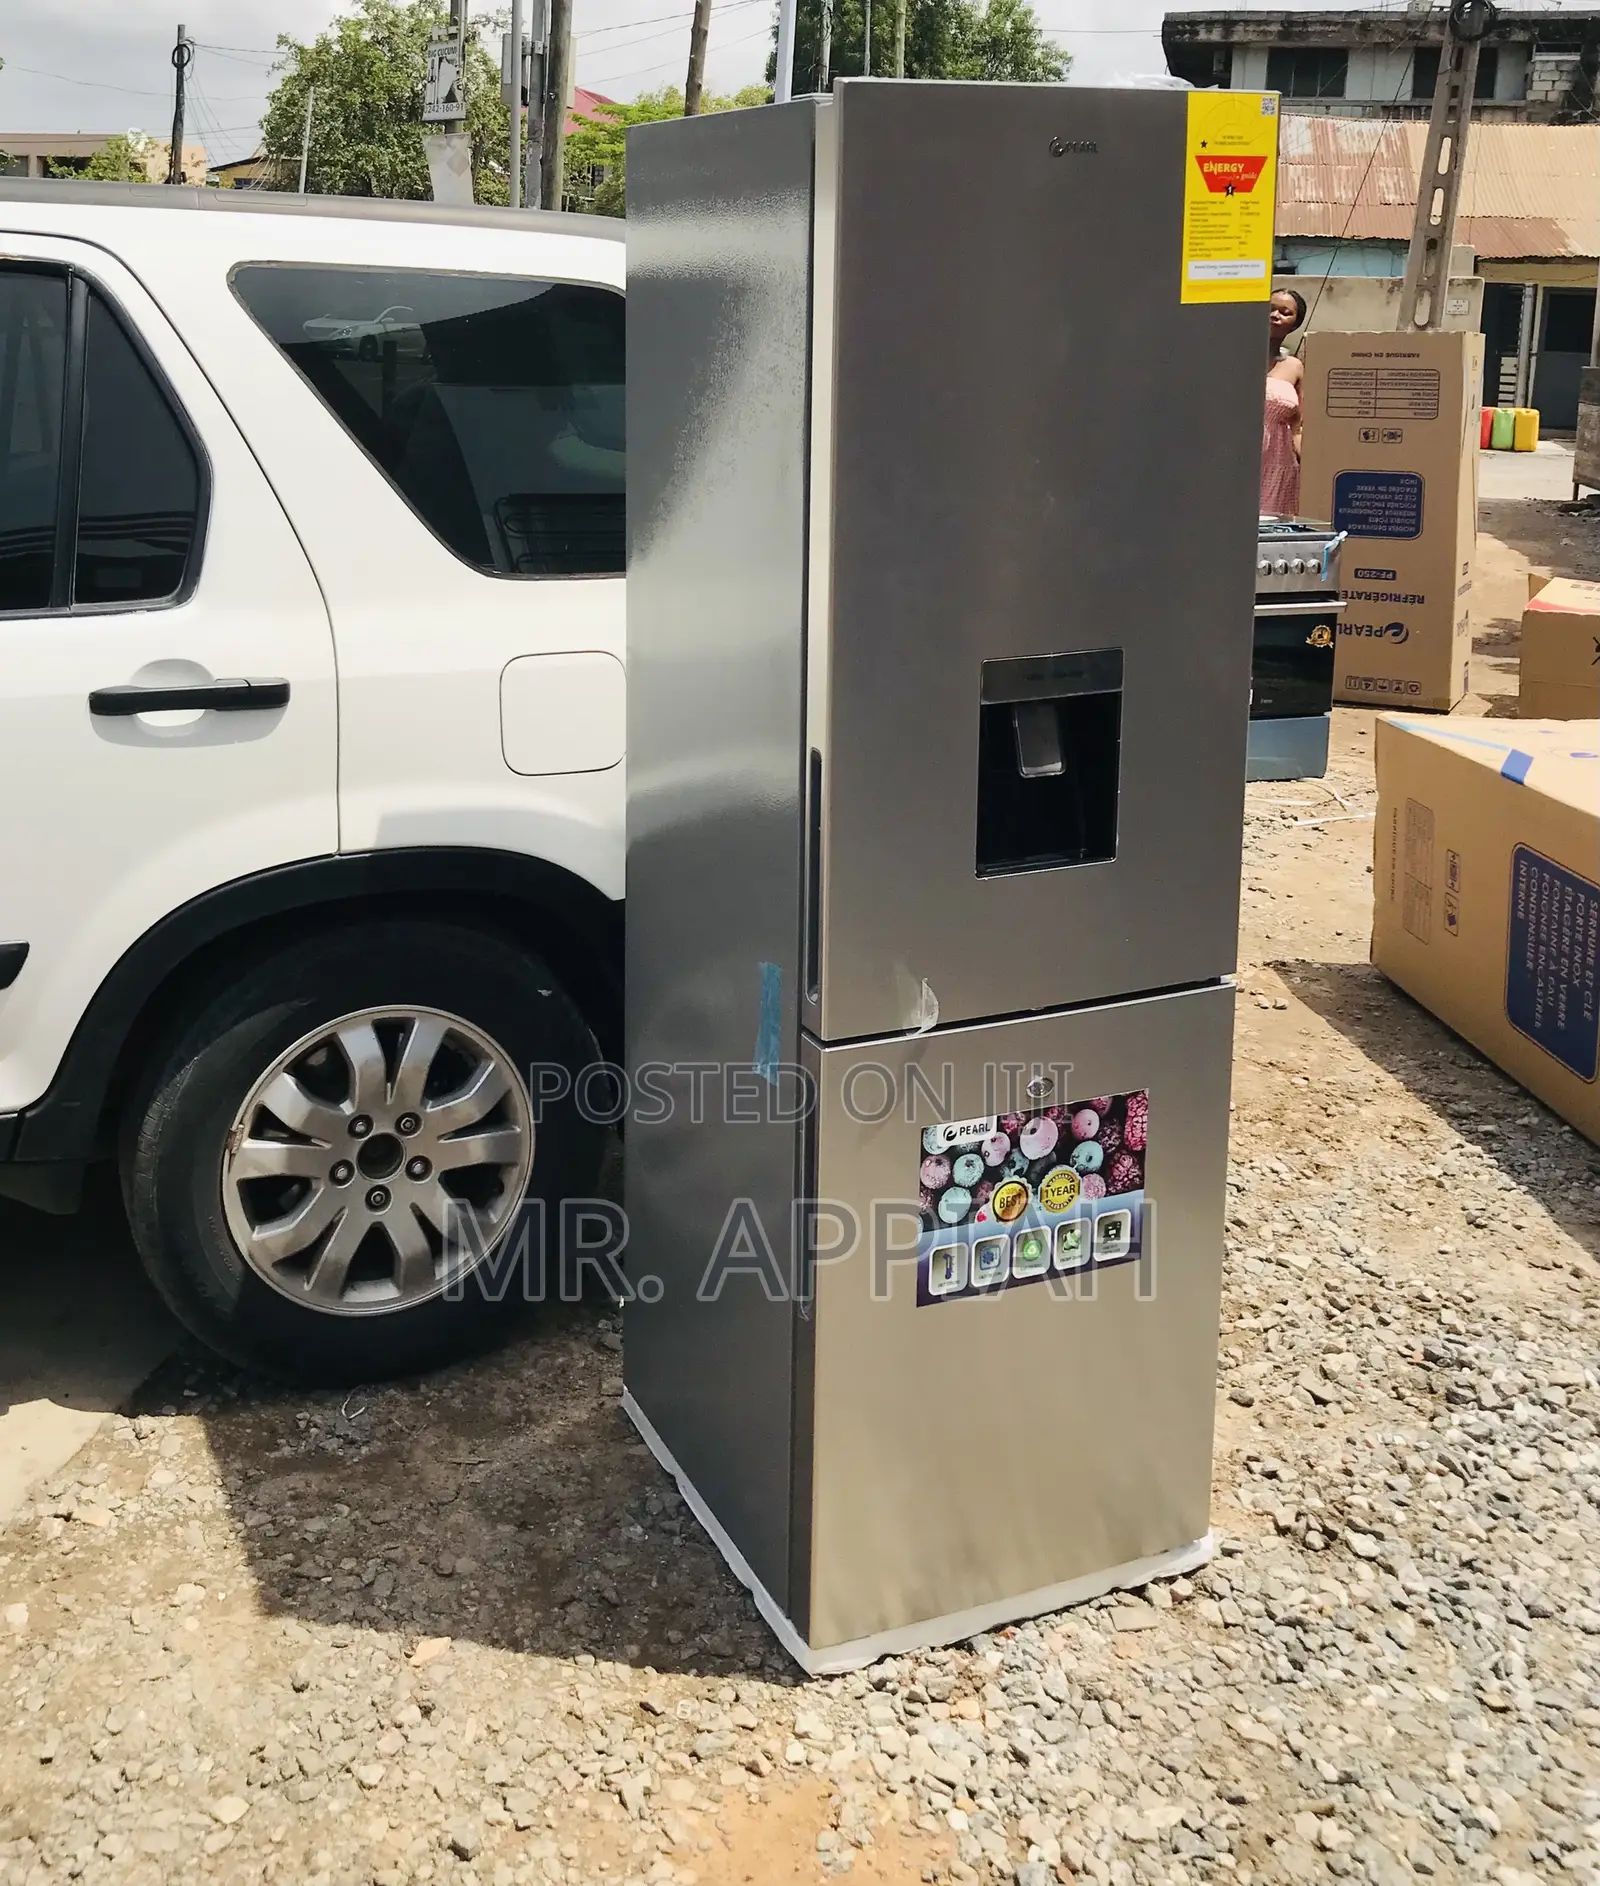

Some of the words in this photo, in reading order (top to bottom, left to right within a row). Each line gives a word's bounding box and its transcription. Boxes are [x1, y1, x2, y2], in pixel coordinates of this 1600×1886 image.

[1203, 161, 1244, 176] ENERGY
[1357, 570, 1393, 579] PF-250
[1338, 590, 1424, 606] RÉFRIGÉRATE
[1337, 623, 1384, 638] PEARL
[1550, 879, 1561, 957] FONTAINE
[1574, 892, 1586, 943] PORTE
[1586, 900, 1598, 966] SERRURE
[1561, 958, 1569, 978] EN
[1572, 946, 1582, 988] INOX
[1585, 970, 1594, 987] ET
[1557, 983, 1567, 1031] VERRE
[959, 1123, 991, 1137] PEARL
[1044, 1189, 1049, 1198] 1
[1050, 1184, 1075, 1196] YEAR
[1000, 1193, 1022, 1208] BEST
